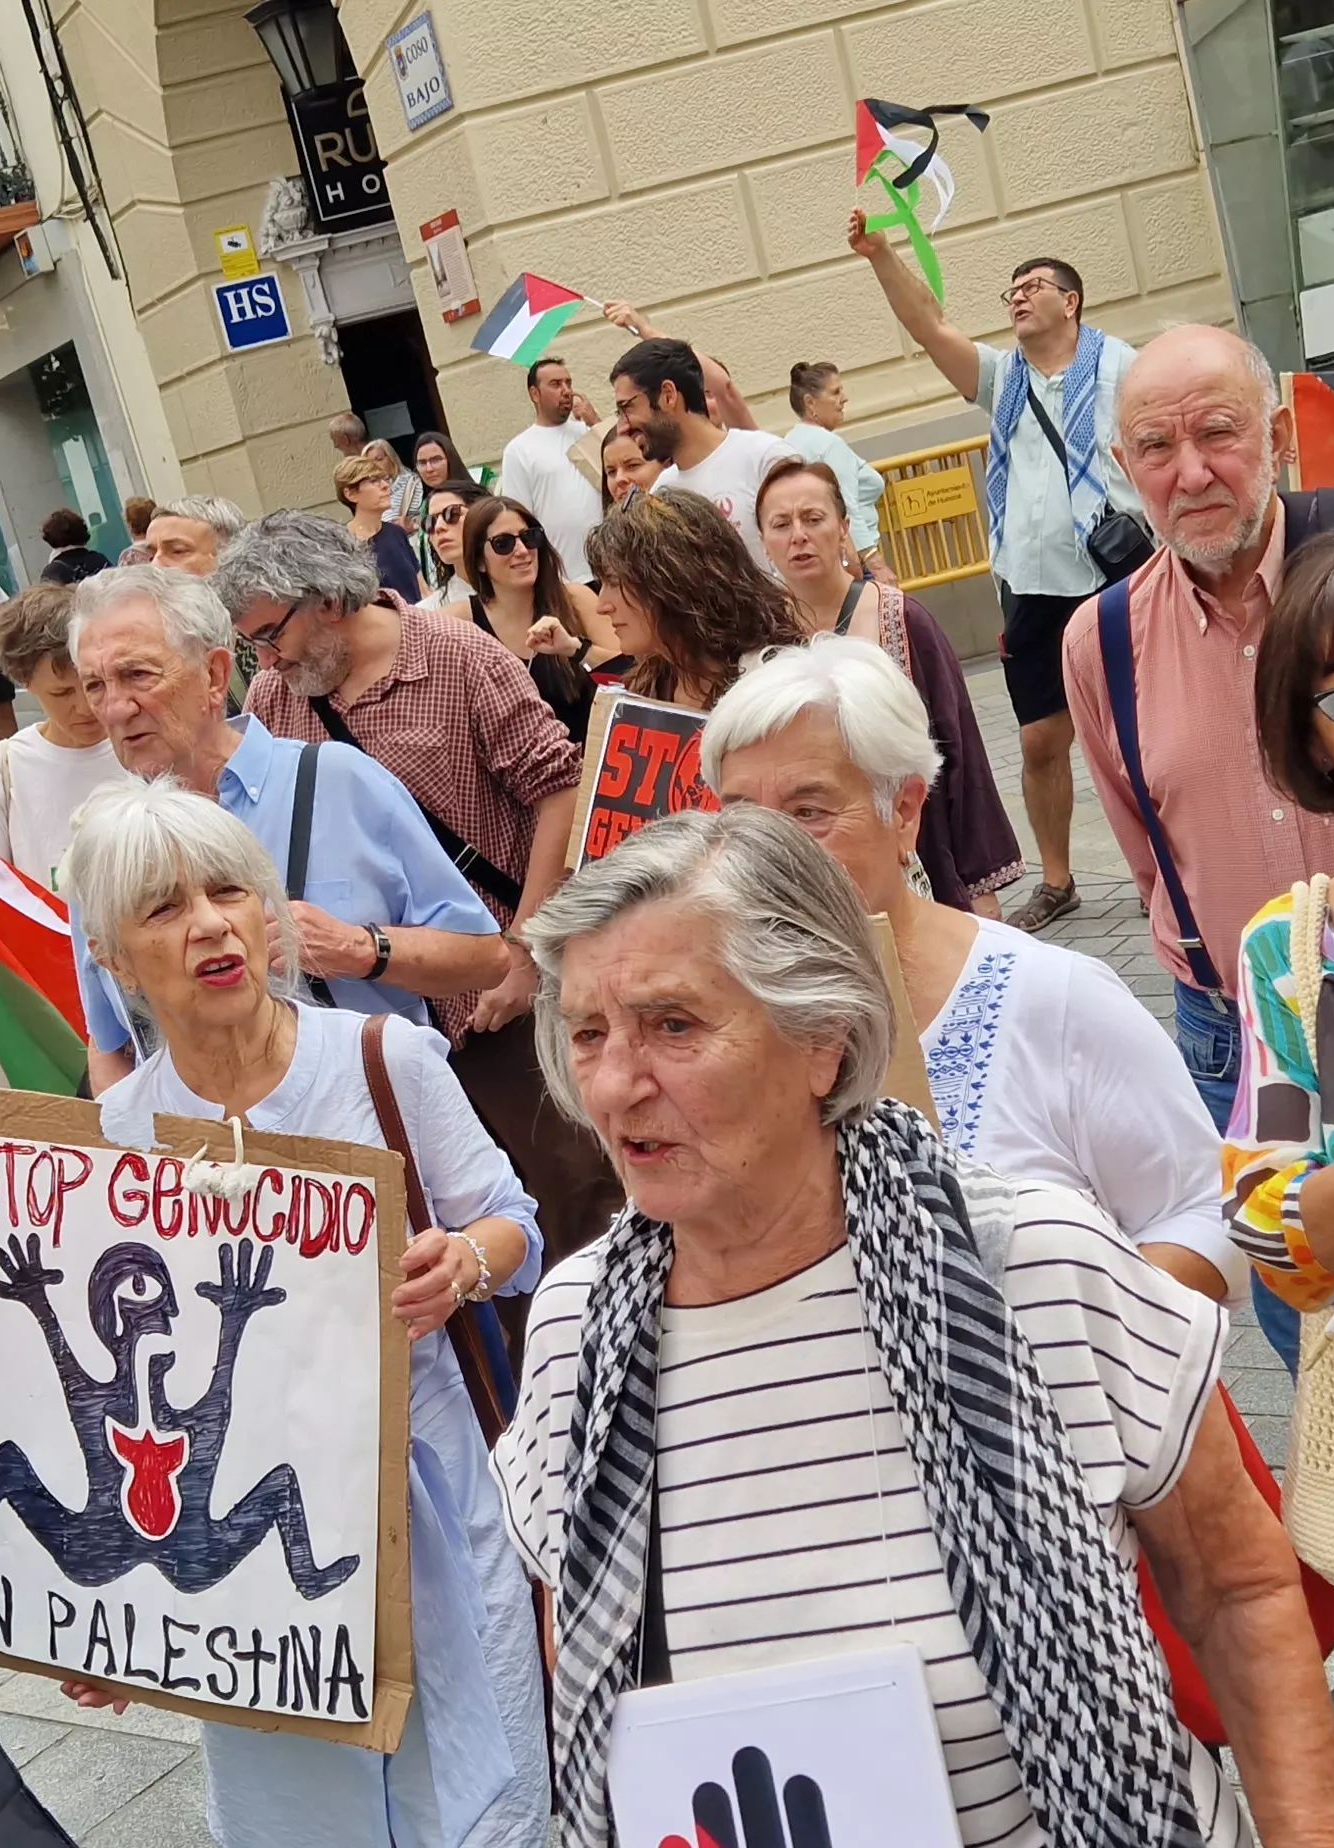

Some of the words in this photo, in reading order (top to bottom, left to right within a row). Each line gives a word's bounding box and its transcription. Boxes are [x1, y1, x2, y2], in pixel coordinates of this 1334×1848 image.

[405, 36, 429, 64] COSO
[407, 76, 440, 109] BAJO
[223, 282, 276, 323] HS
